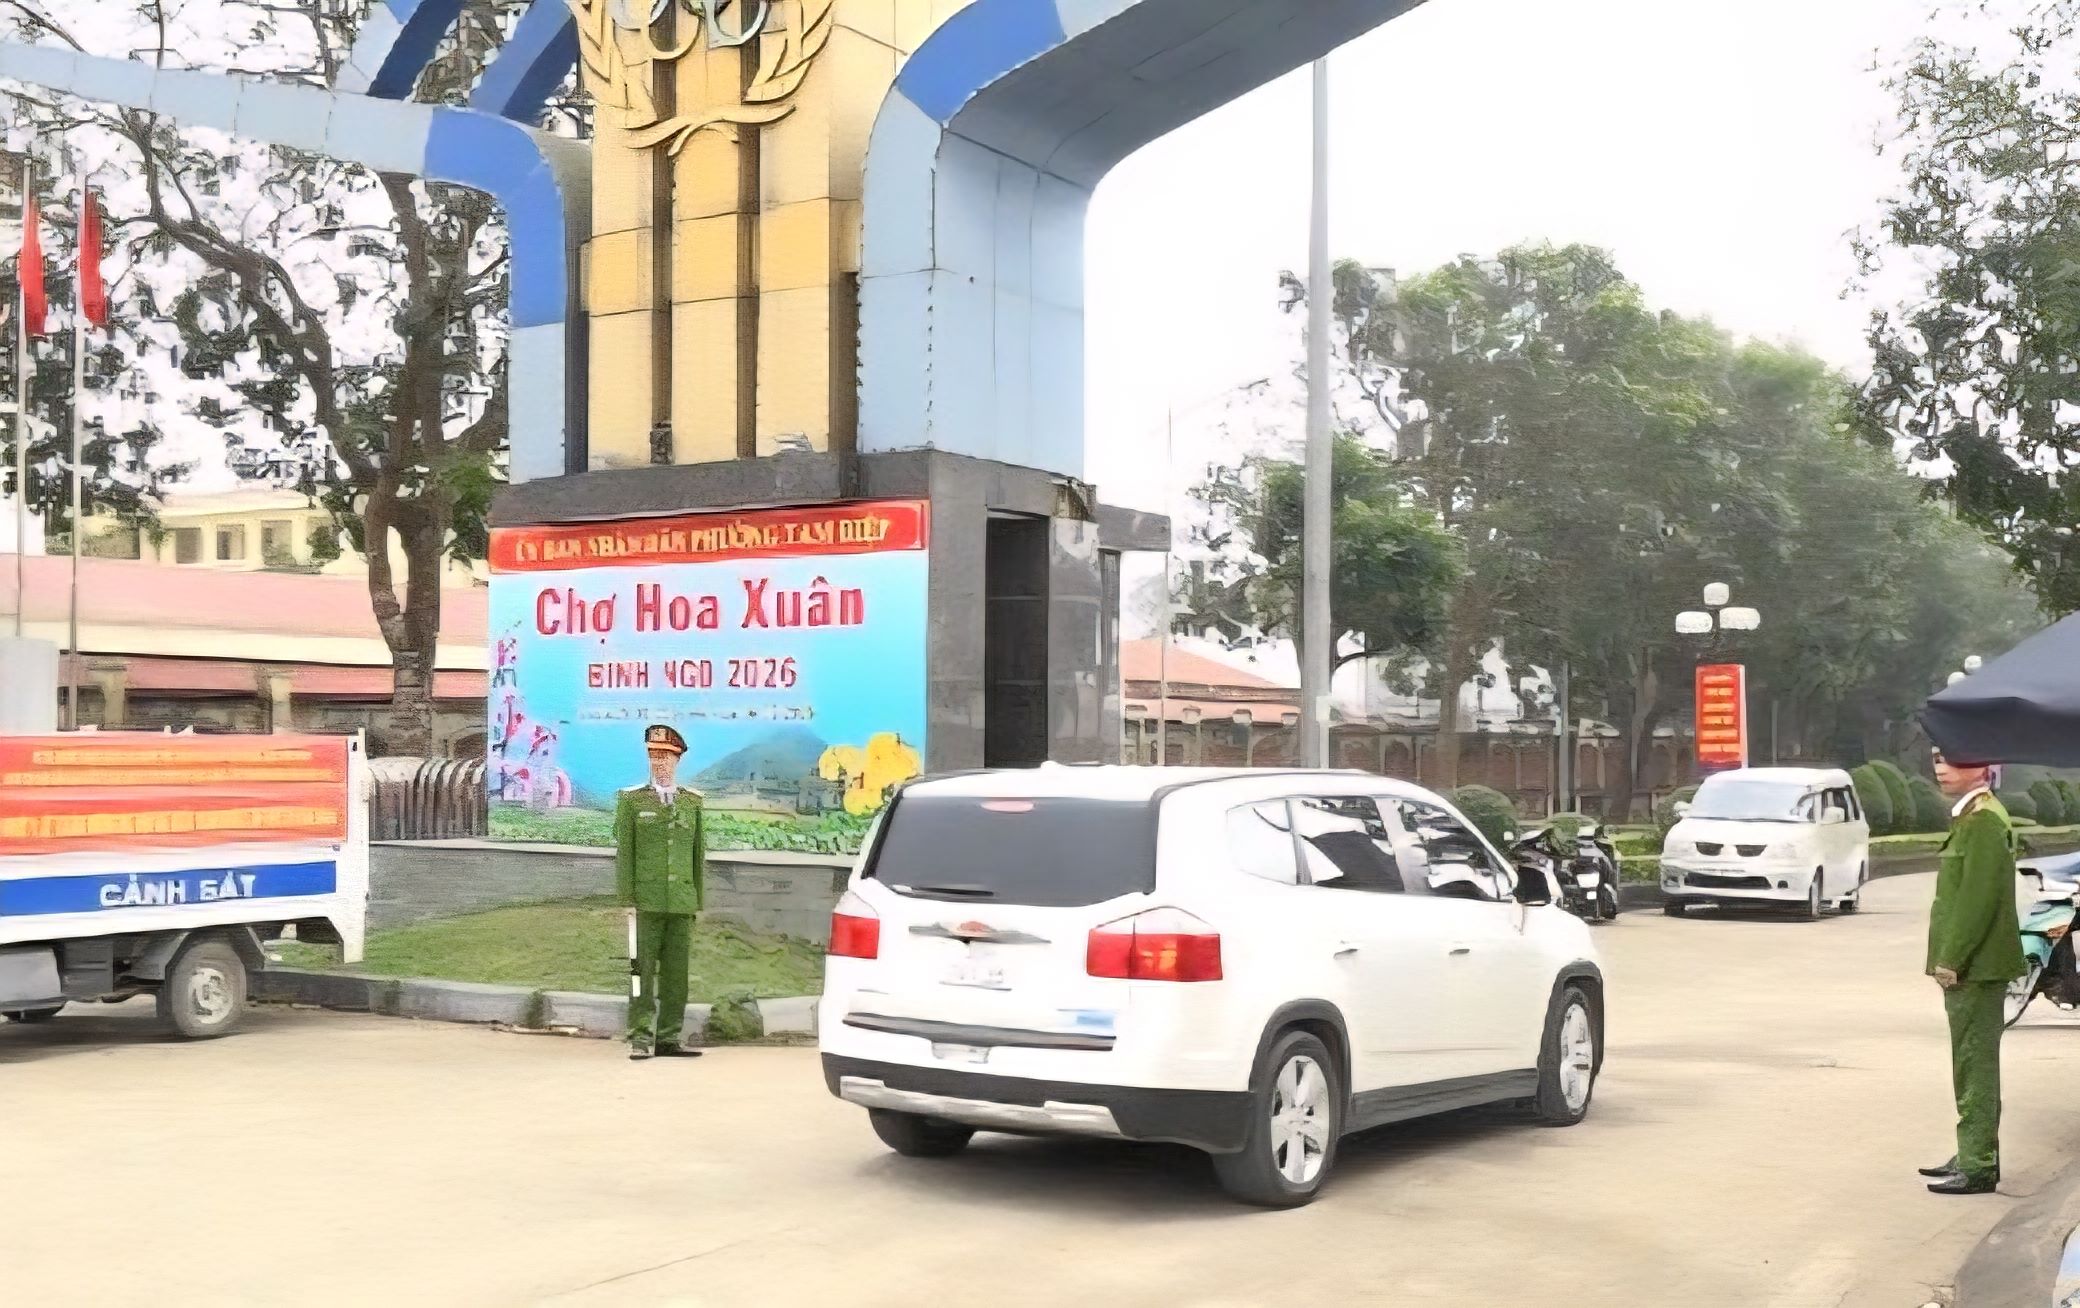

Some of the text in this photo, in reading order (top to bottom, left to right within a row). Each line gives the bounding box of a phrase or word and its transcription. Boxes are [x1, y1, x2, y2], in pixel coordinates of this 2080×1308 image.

[535, 574, 865, 645] Chợ Hoa Xuân
[728, 656, 798, 688] 2026
